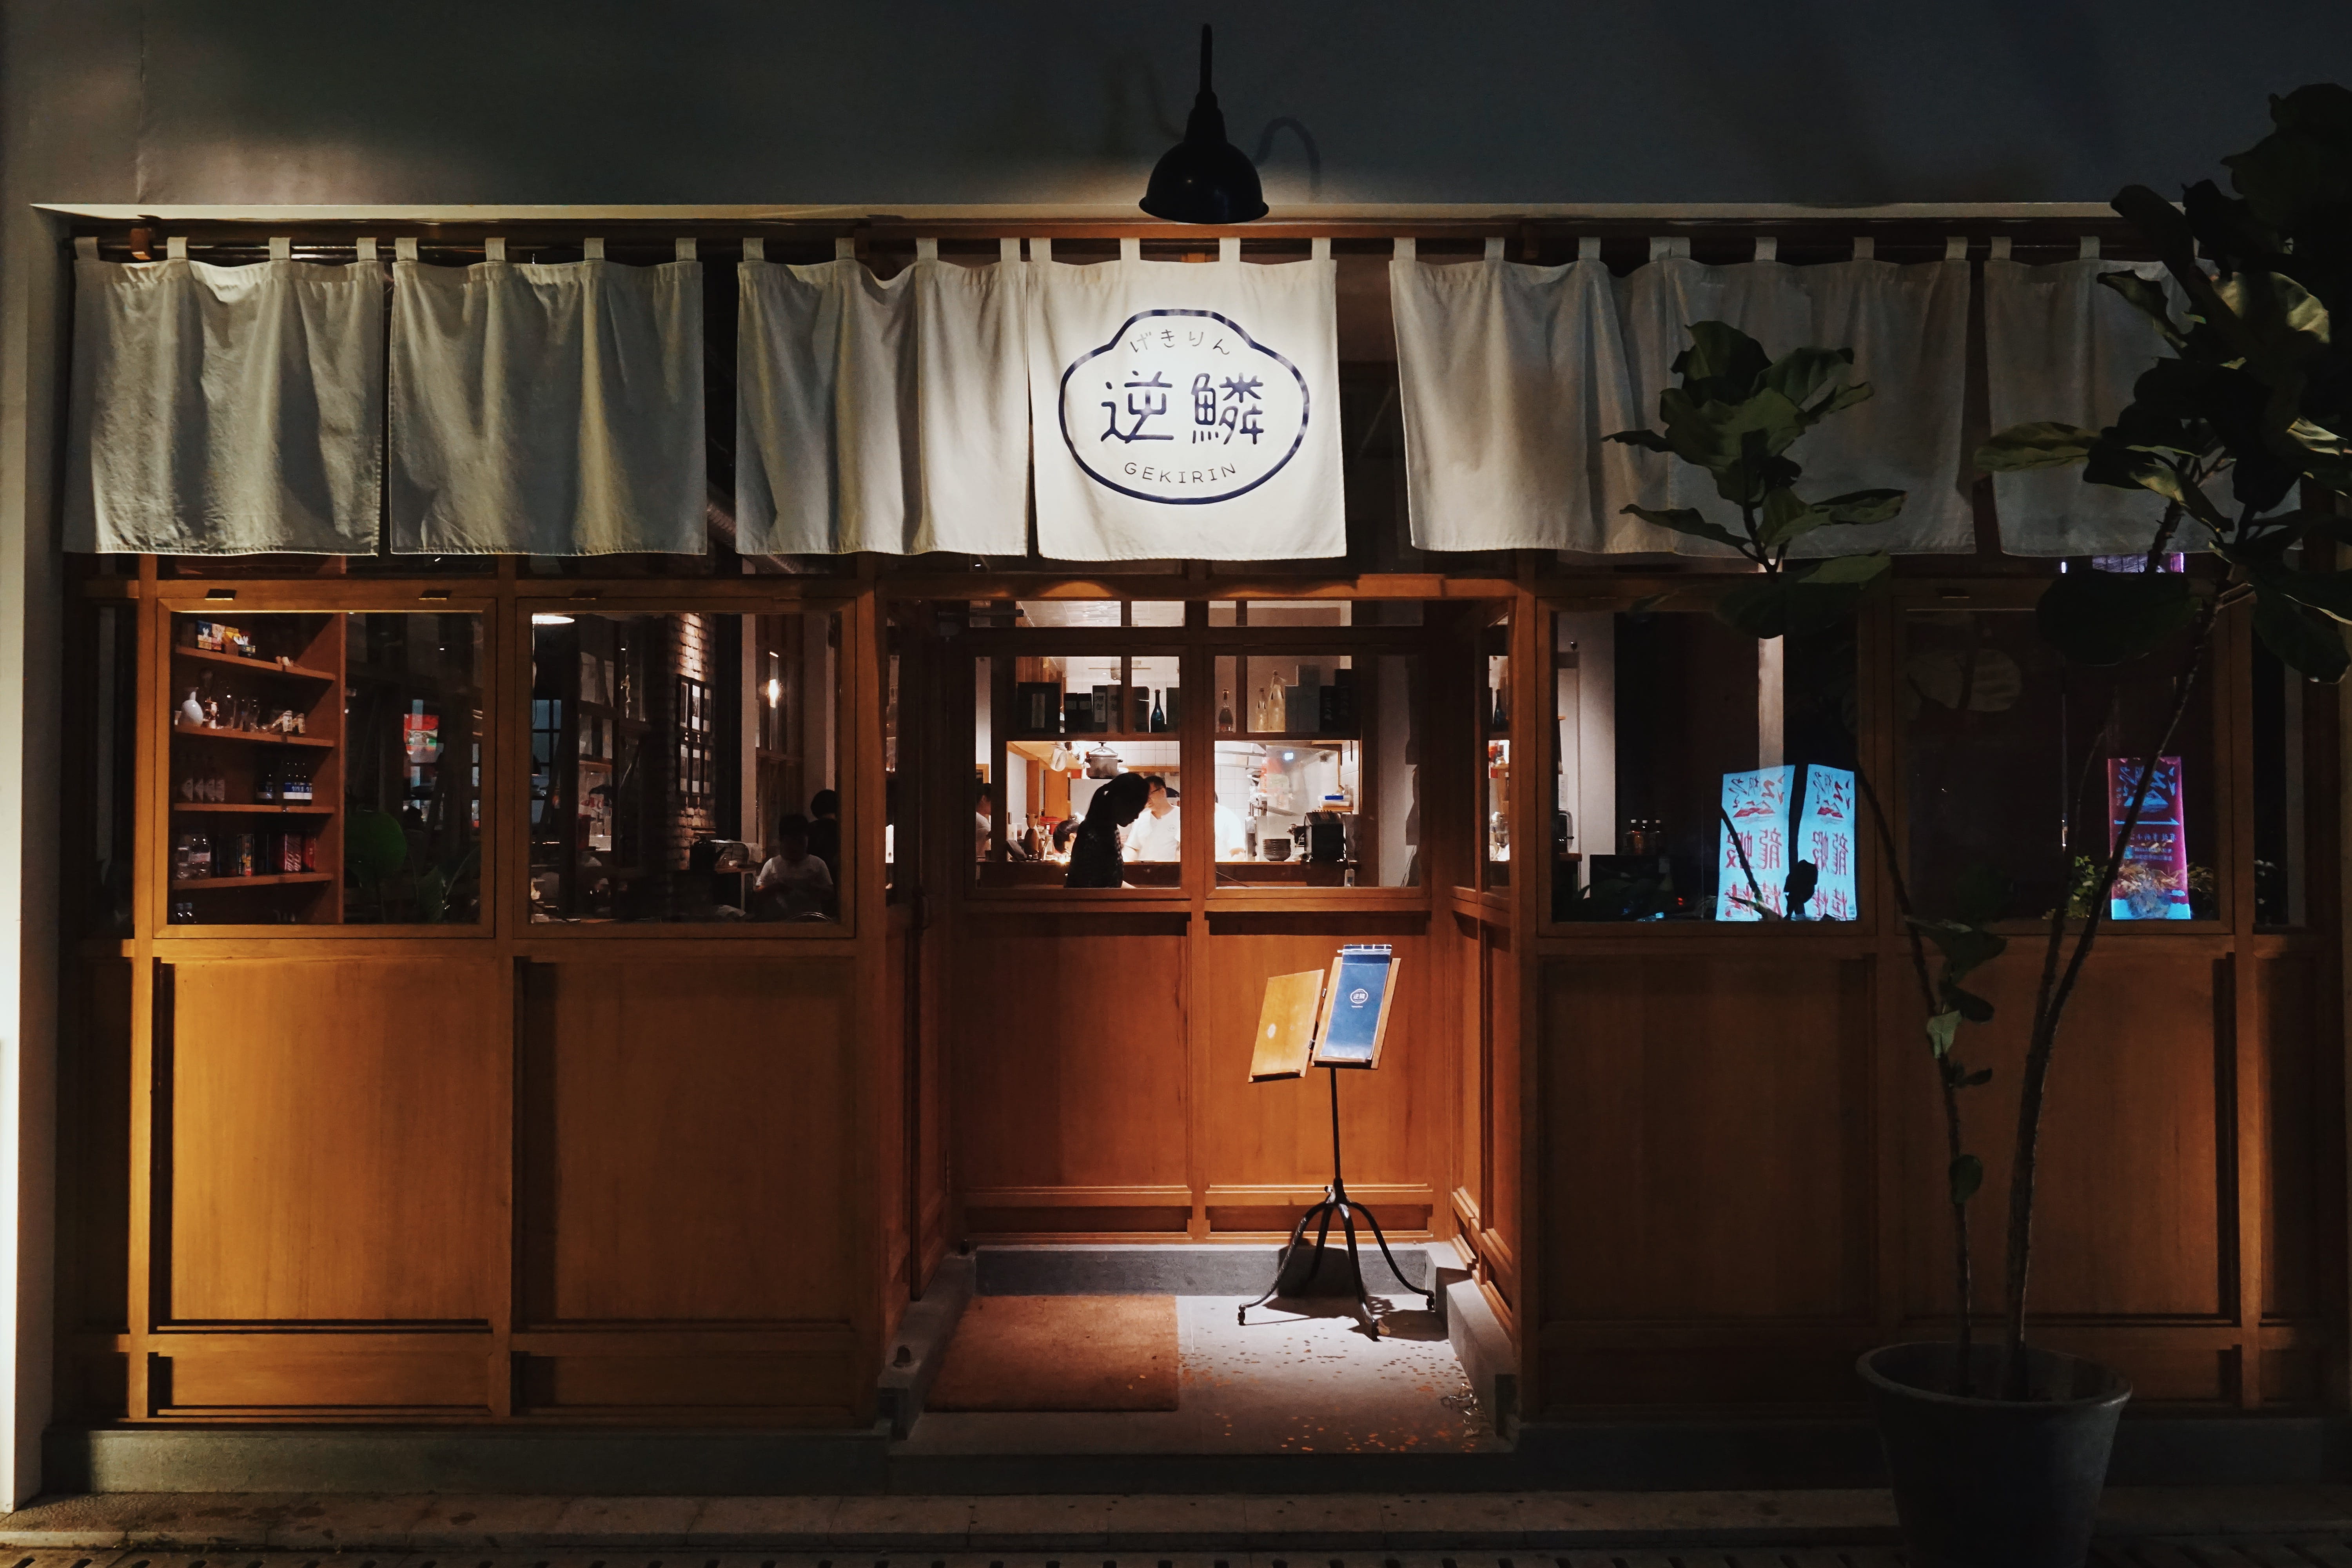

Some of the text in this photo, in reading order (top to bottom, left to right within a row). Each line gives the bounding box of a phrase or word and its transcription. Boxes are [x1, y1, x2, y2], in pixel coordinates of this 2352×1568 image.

[1130, 329, 1231, 355] げきりん
[1101, 370, 1264, 445] 逆鱗
[1124, 462, 1236, 483] GEKIRIN
